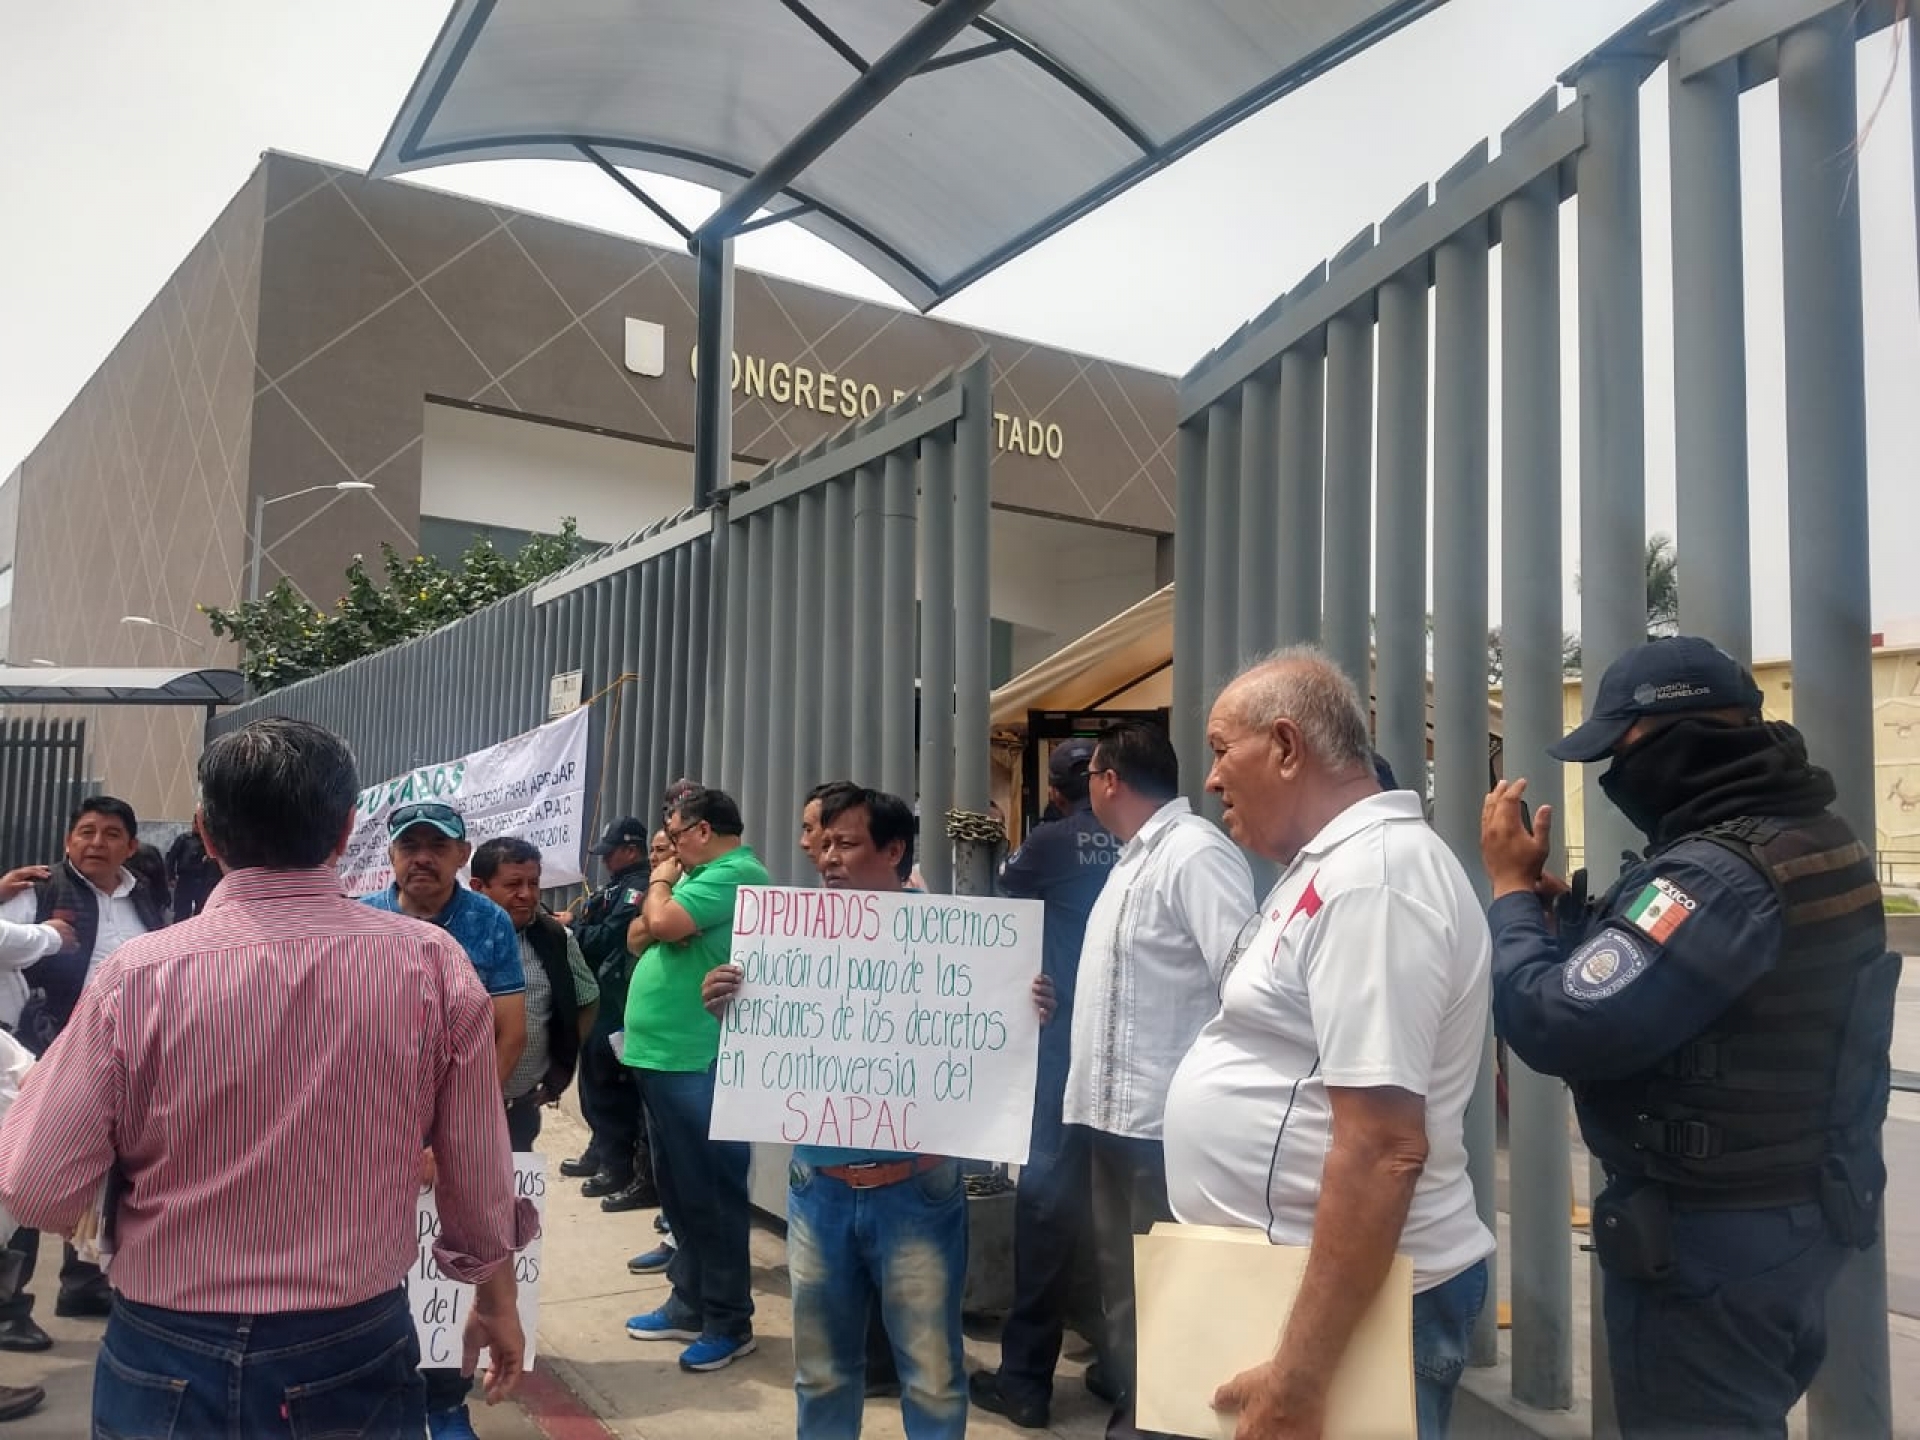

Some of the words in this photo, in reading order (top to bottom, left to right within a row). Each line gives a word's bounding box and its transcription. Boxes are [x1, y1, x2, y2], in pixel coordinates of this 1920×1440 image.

[734, 888, 880, 941] DIPUTADOS
[893, 904, 1018, 954] queremos
[817, 944, 841, 990] al
[847, 956, 898, 1006] pago
[900, 950, 925, 995] de
[937, 953, 973, 997] las
[724, 993, 825, 1047] pensiones
[832, 993, 855, 1042] de
[862, 997, 895, 1044] los
[905, 1000, 1007, 1051] decretos
[719, 1048, 745, 1090] en
[761, 1044, 917, 1099] controversia
[934, 1054, 973, 1102] del
[782, 1090, 921, 1151] SAPAC
[422, 1286, 460, 1324] del
